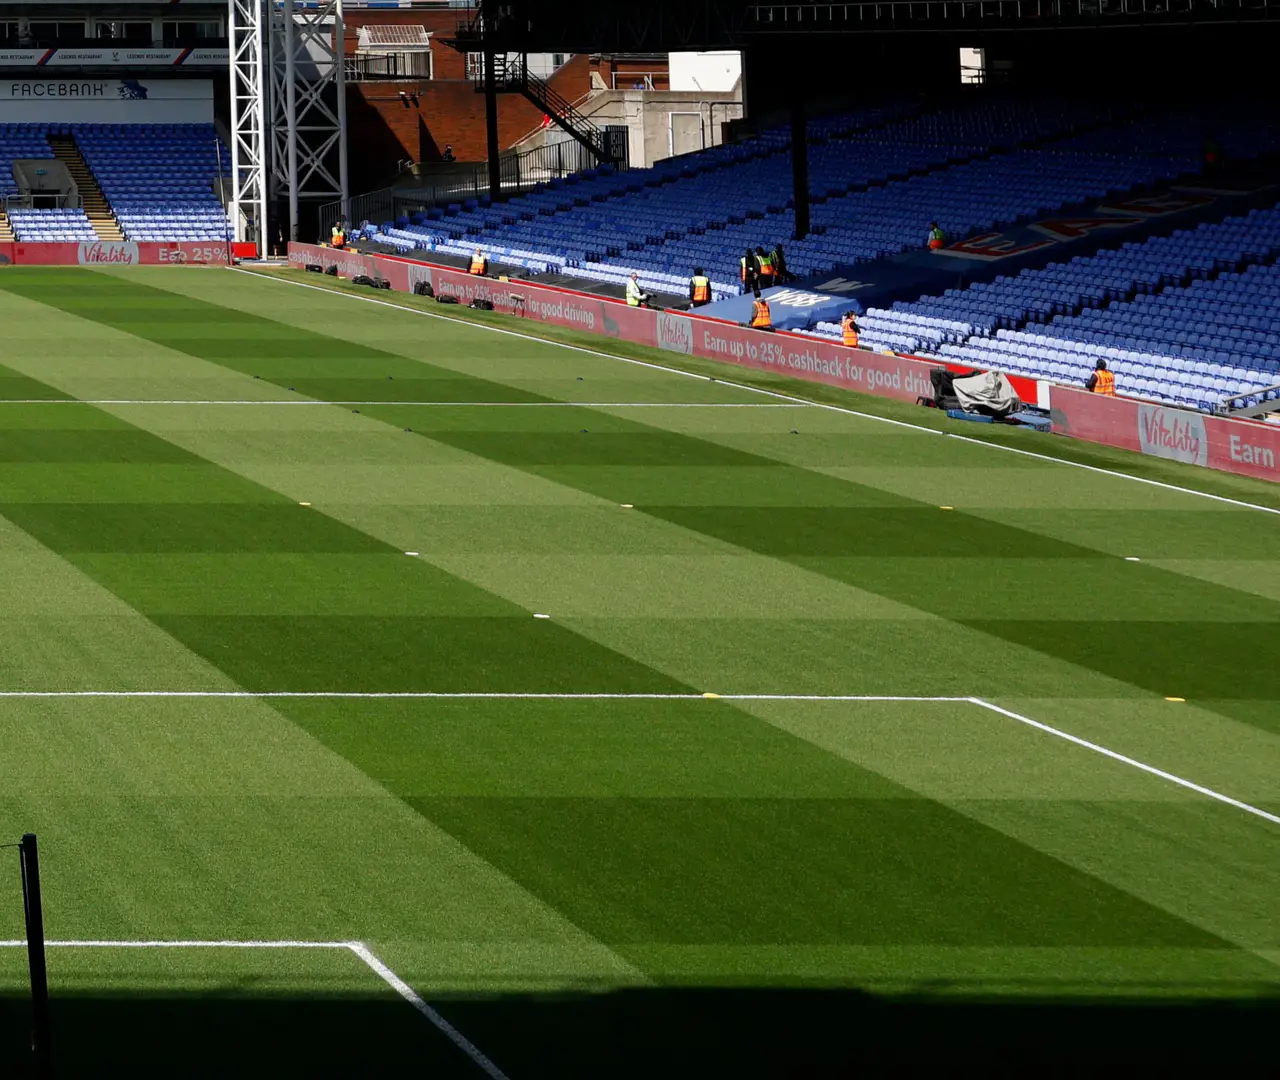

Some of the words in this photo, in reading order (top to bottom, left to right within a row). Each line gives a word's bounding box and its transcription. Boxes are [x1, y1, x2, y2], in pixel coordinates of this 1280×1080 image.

[11, 83, 104, 97] FACEBANK
[83, 243, 132, 265] Vitality
[192, 247, 229, 261] 25%
[438, 277, 455, 294] Earn
[455, 285, 465, 301] up
[465, 284, 474, 299] to
[474, 283, 492, 301] 25%
[528, 295, 540, 312] for
[541, 300, 563, 319] good
[564, 302, 595, 329] driving
[658, 316, 690, 353] Vitality
[704, 330, 728, 354] Earn
[729, 338, 745, 360] up
[746, 340, 758, 359] to
[759, 342, 786, 367] 25%
[788, 347, 843, 378] cashback
[845, 361, 865, 381] for
[866, 364, 901, 391] good
[904, 371, 932, 396] driv
[1144, 407, 1201, 465] Vitality
[1230, 434, 1275, 468] Earn
